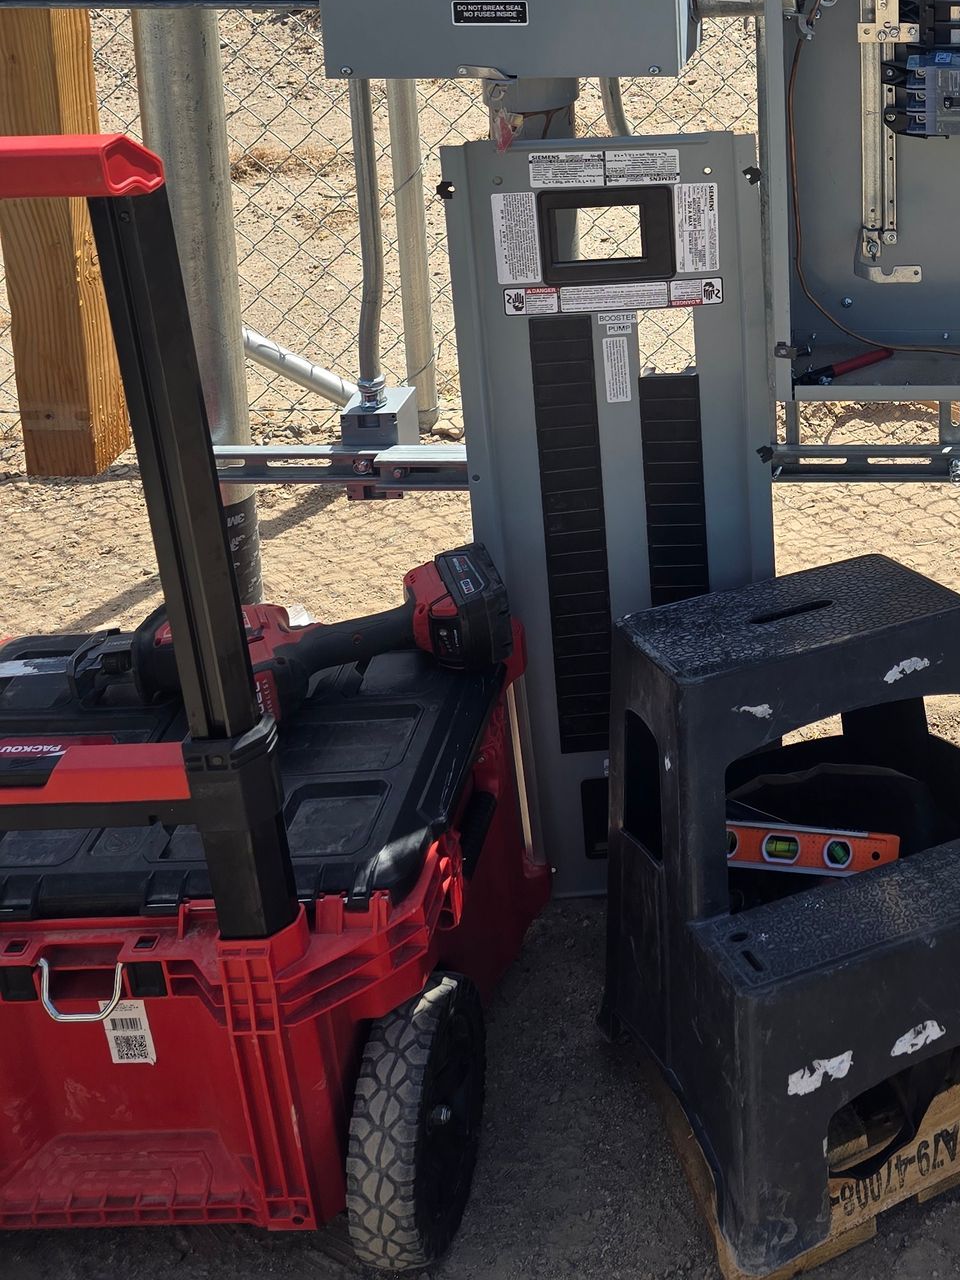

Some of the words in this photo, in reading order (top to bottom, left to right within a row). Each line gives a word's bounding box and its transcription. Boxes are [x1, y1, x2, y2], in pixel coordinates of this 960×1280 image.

[457, 4, 467, 12] DO
[468, 4, 482, 12] NOT
[599, 313, 637, 322] BOOSTER
[608, 324, 631, 332] PUMP
[0, 744, 62, 753] PACKOU
